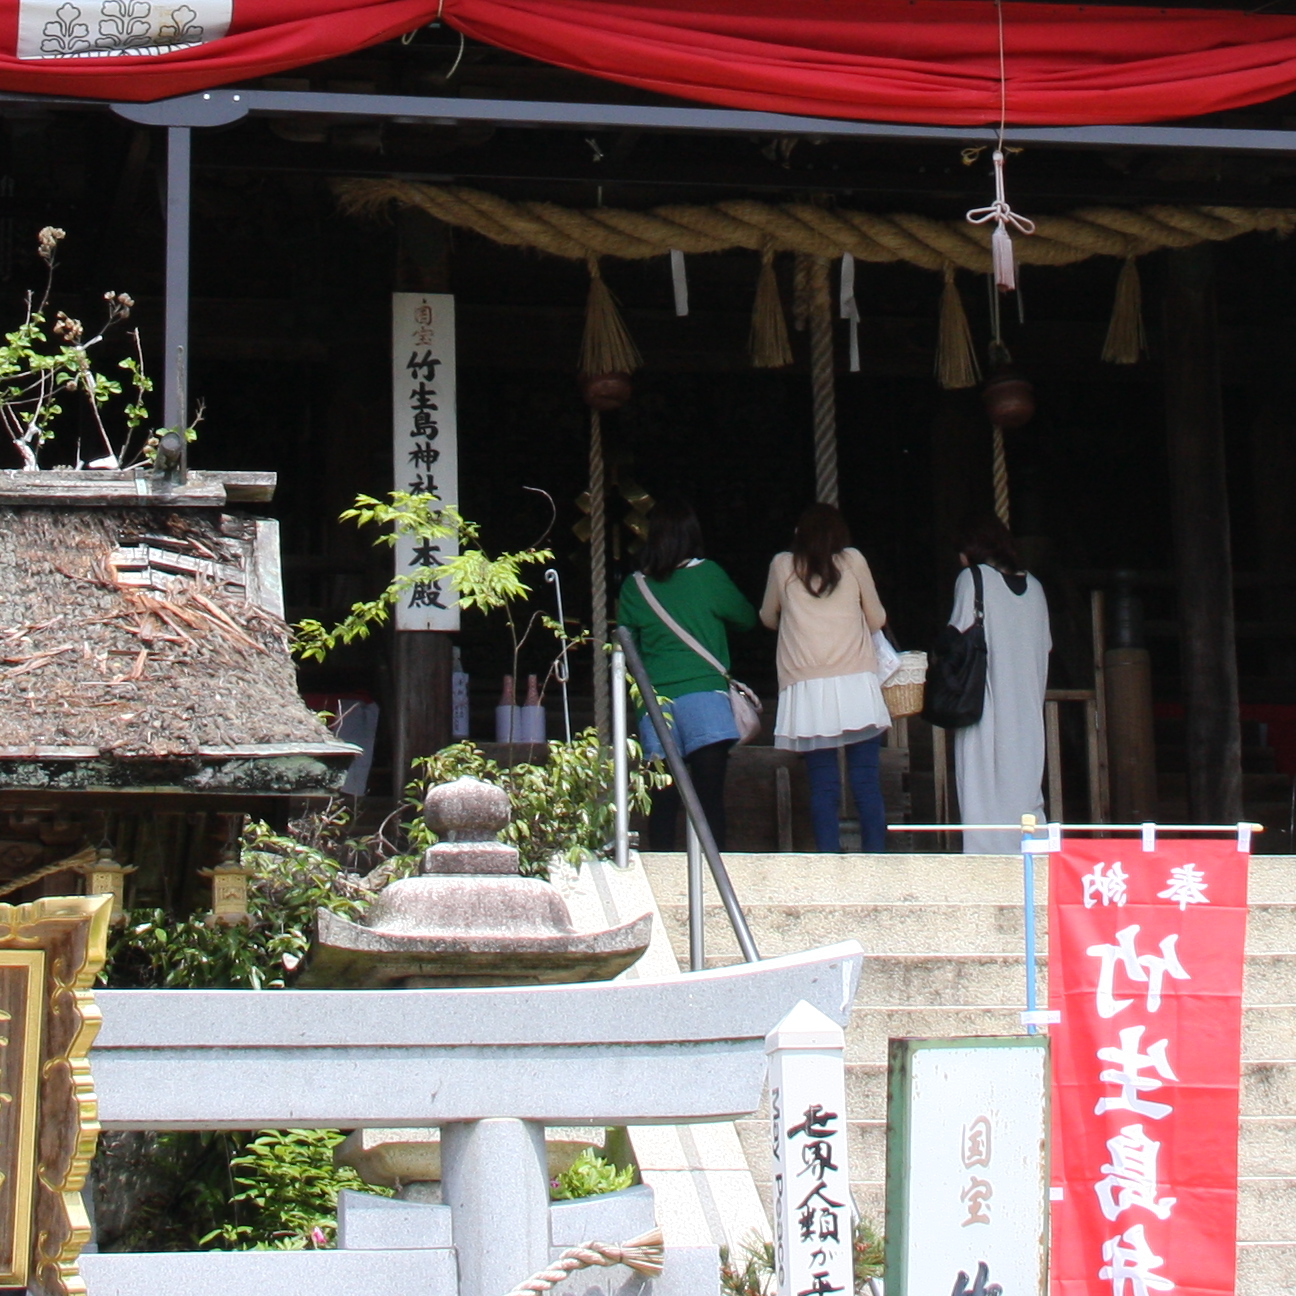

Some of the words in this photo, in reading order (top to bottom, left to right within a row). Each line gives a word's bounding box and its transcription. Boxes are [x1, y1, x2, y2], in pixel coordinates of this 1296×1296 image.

[406, 349, 449, 610] 竹生島神社本殿
[960, 1115, 994, 1227] 国宝
